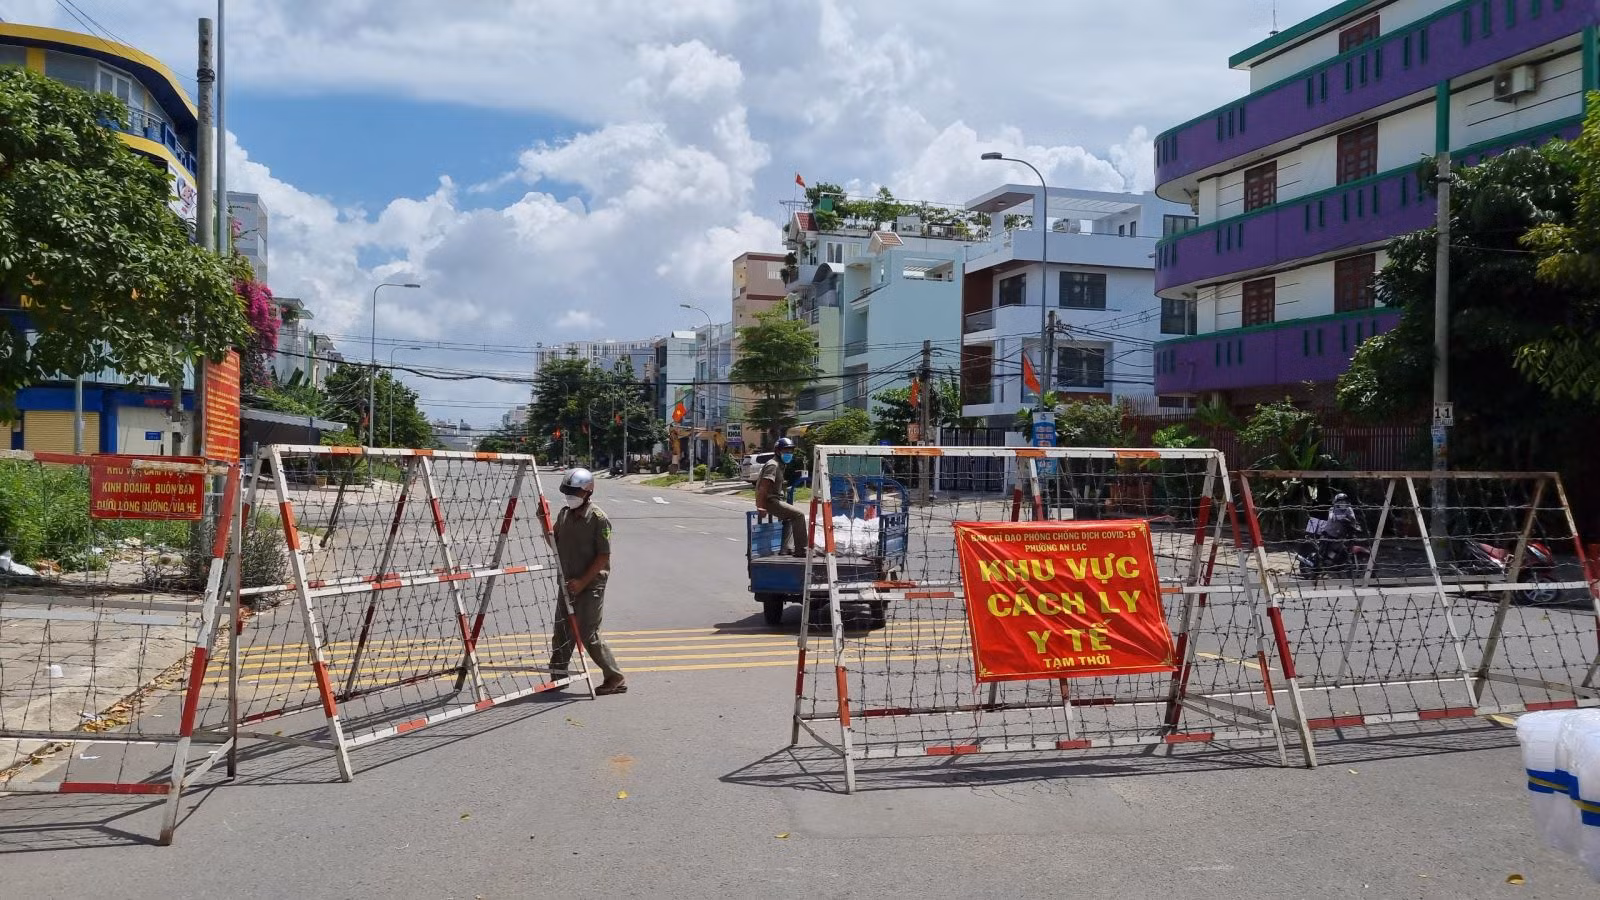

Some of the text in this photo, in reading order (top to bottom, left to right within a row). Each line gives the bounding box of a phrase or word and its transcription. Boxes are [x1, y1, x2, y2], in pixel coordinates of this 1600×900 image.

[102, 481, 121, 493] KINH
[988, 532, 1003, 542] CHỈ
[1004, 533, 1022, 543] ĐẠO
[1023, 530, 1051, 541] PHÒNG
[1052, 529, 1080, 540] CHỐNG
[1081, 531, 1100, 541] DỊCH
[1101, 530, 1136, 539] COVID-19
[1025, 543, 1087, 552] PHƯỜNG AN LẠC
[978, 553, 1140, 584] KHU VỰC
[987, 586, 1141, 617] CÁCH LY
[1027, 618, 1112, 654] Y TẾ
[1043, 654, 1111, 669] TẠM THỜI
